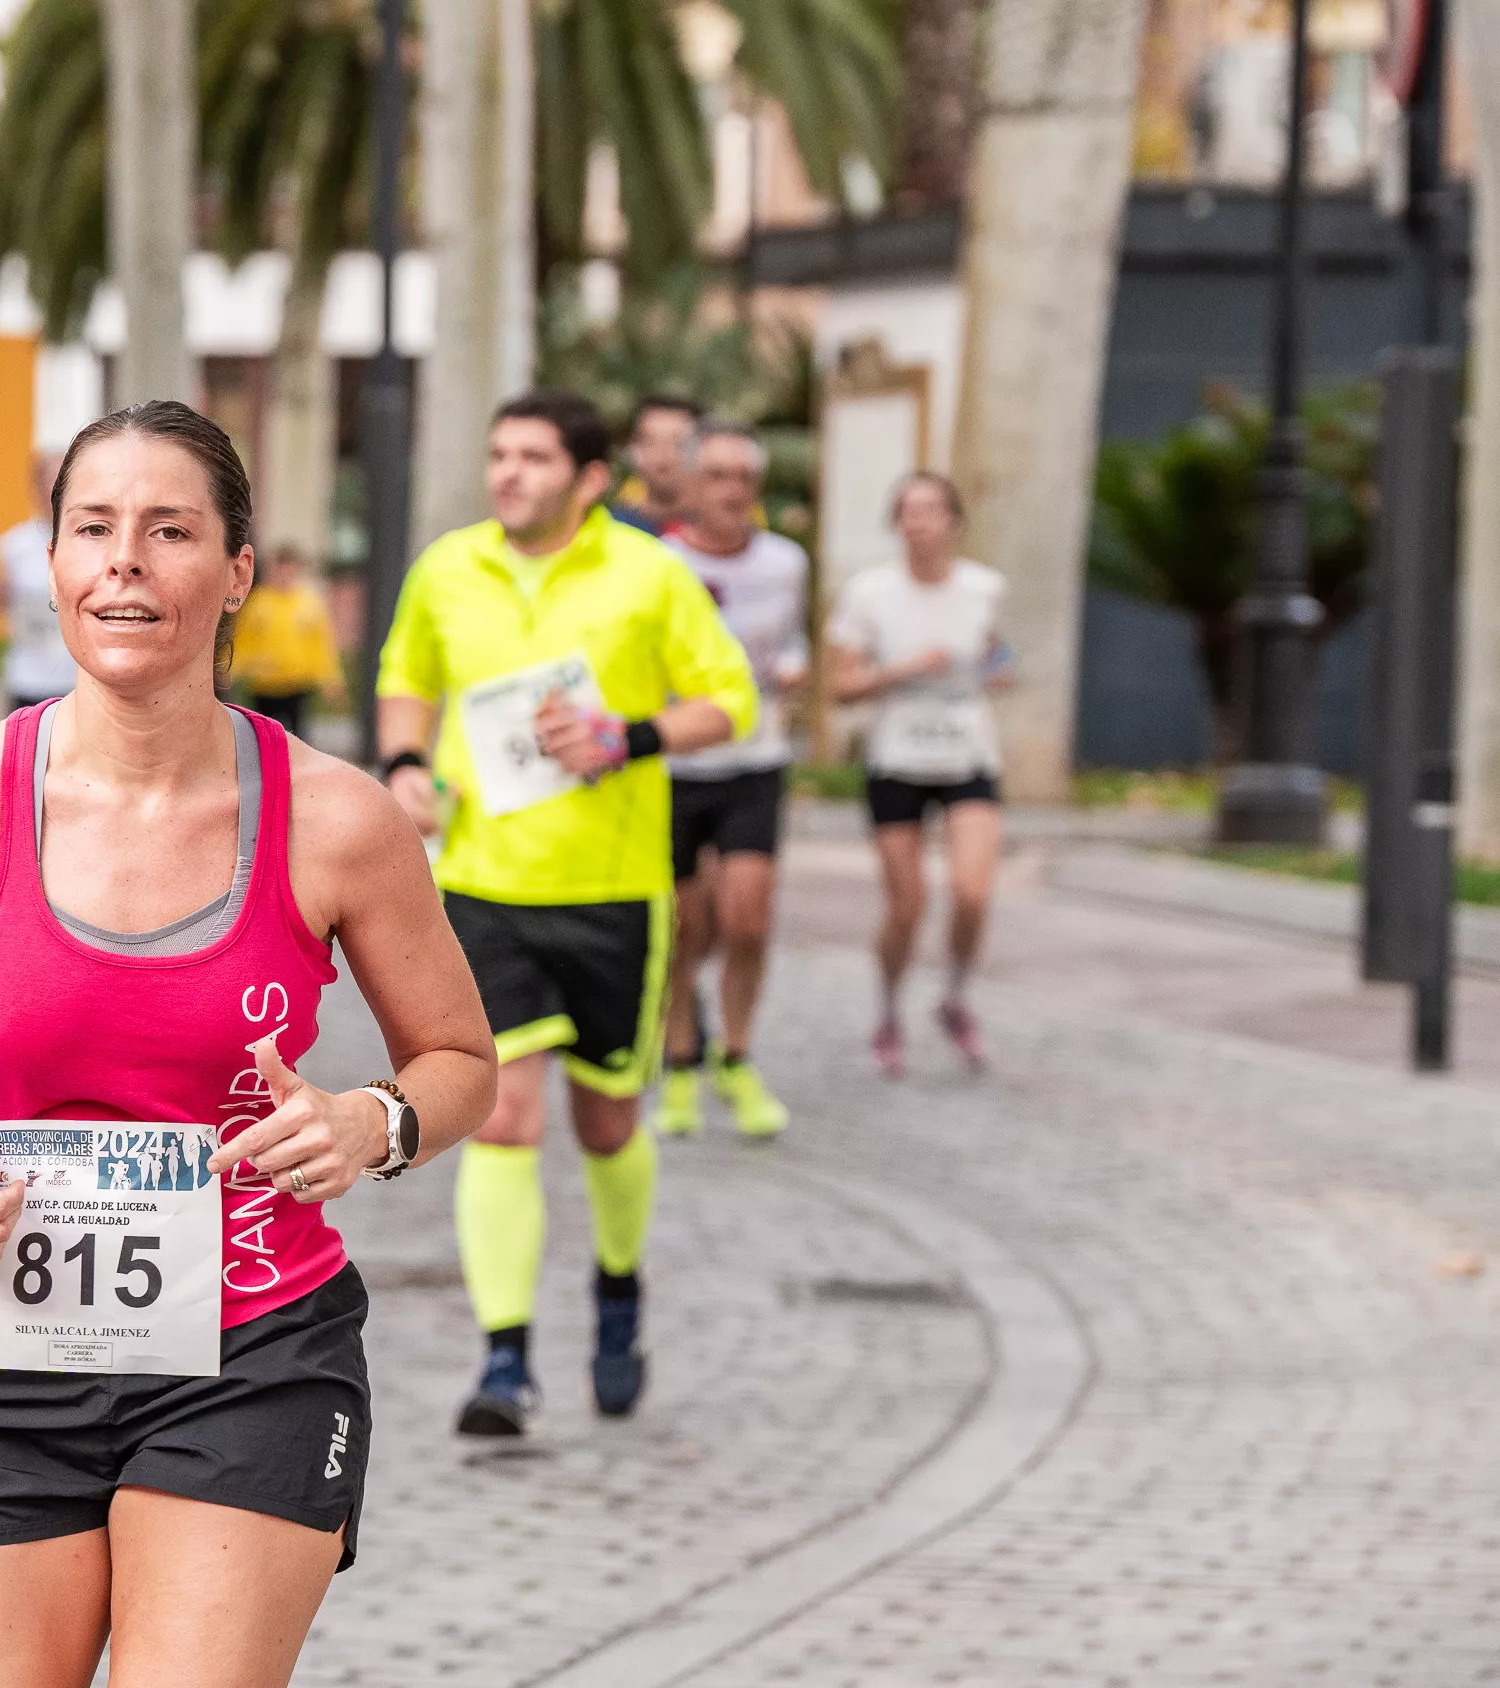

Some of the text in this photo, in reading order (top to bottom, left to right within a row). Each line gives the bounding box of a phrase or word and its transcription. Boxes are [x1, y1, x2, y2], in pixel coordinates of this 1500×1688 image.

[22, 1131, 77, 1143] PROVINCIAL
[80, 1132, 93, 1144] DE
[32, 1143, 93, 1156] POPULARES
[97, 1131, 165, 1159] 2024
[32, 1157, 42, 1166] DE
[26, 1199, 158, 1212] XXV C.P. CIUDAD DE LUCENA
[43, 1215, 130, 1226] POR LA IGUALDAD
[13, 1232, 162, 1308] 815
[15, 1325, 151, 1338] SILVIA ALCALA JIMENEZ
[324, 1412, 350, 1479] FILA
